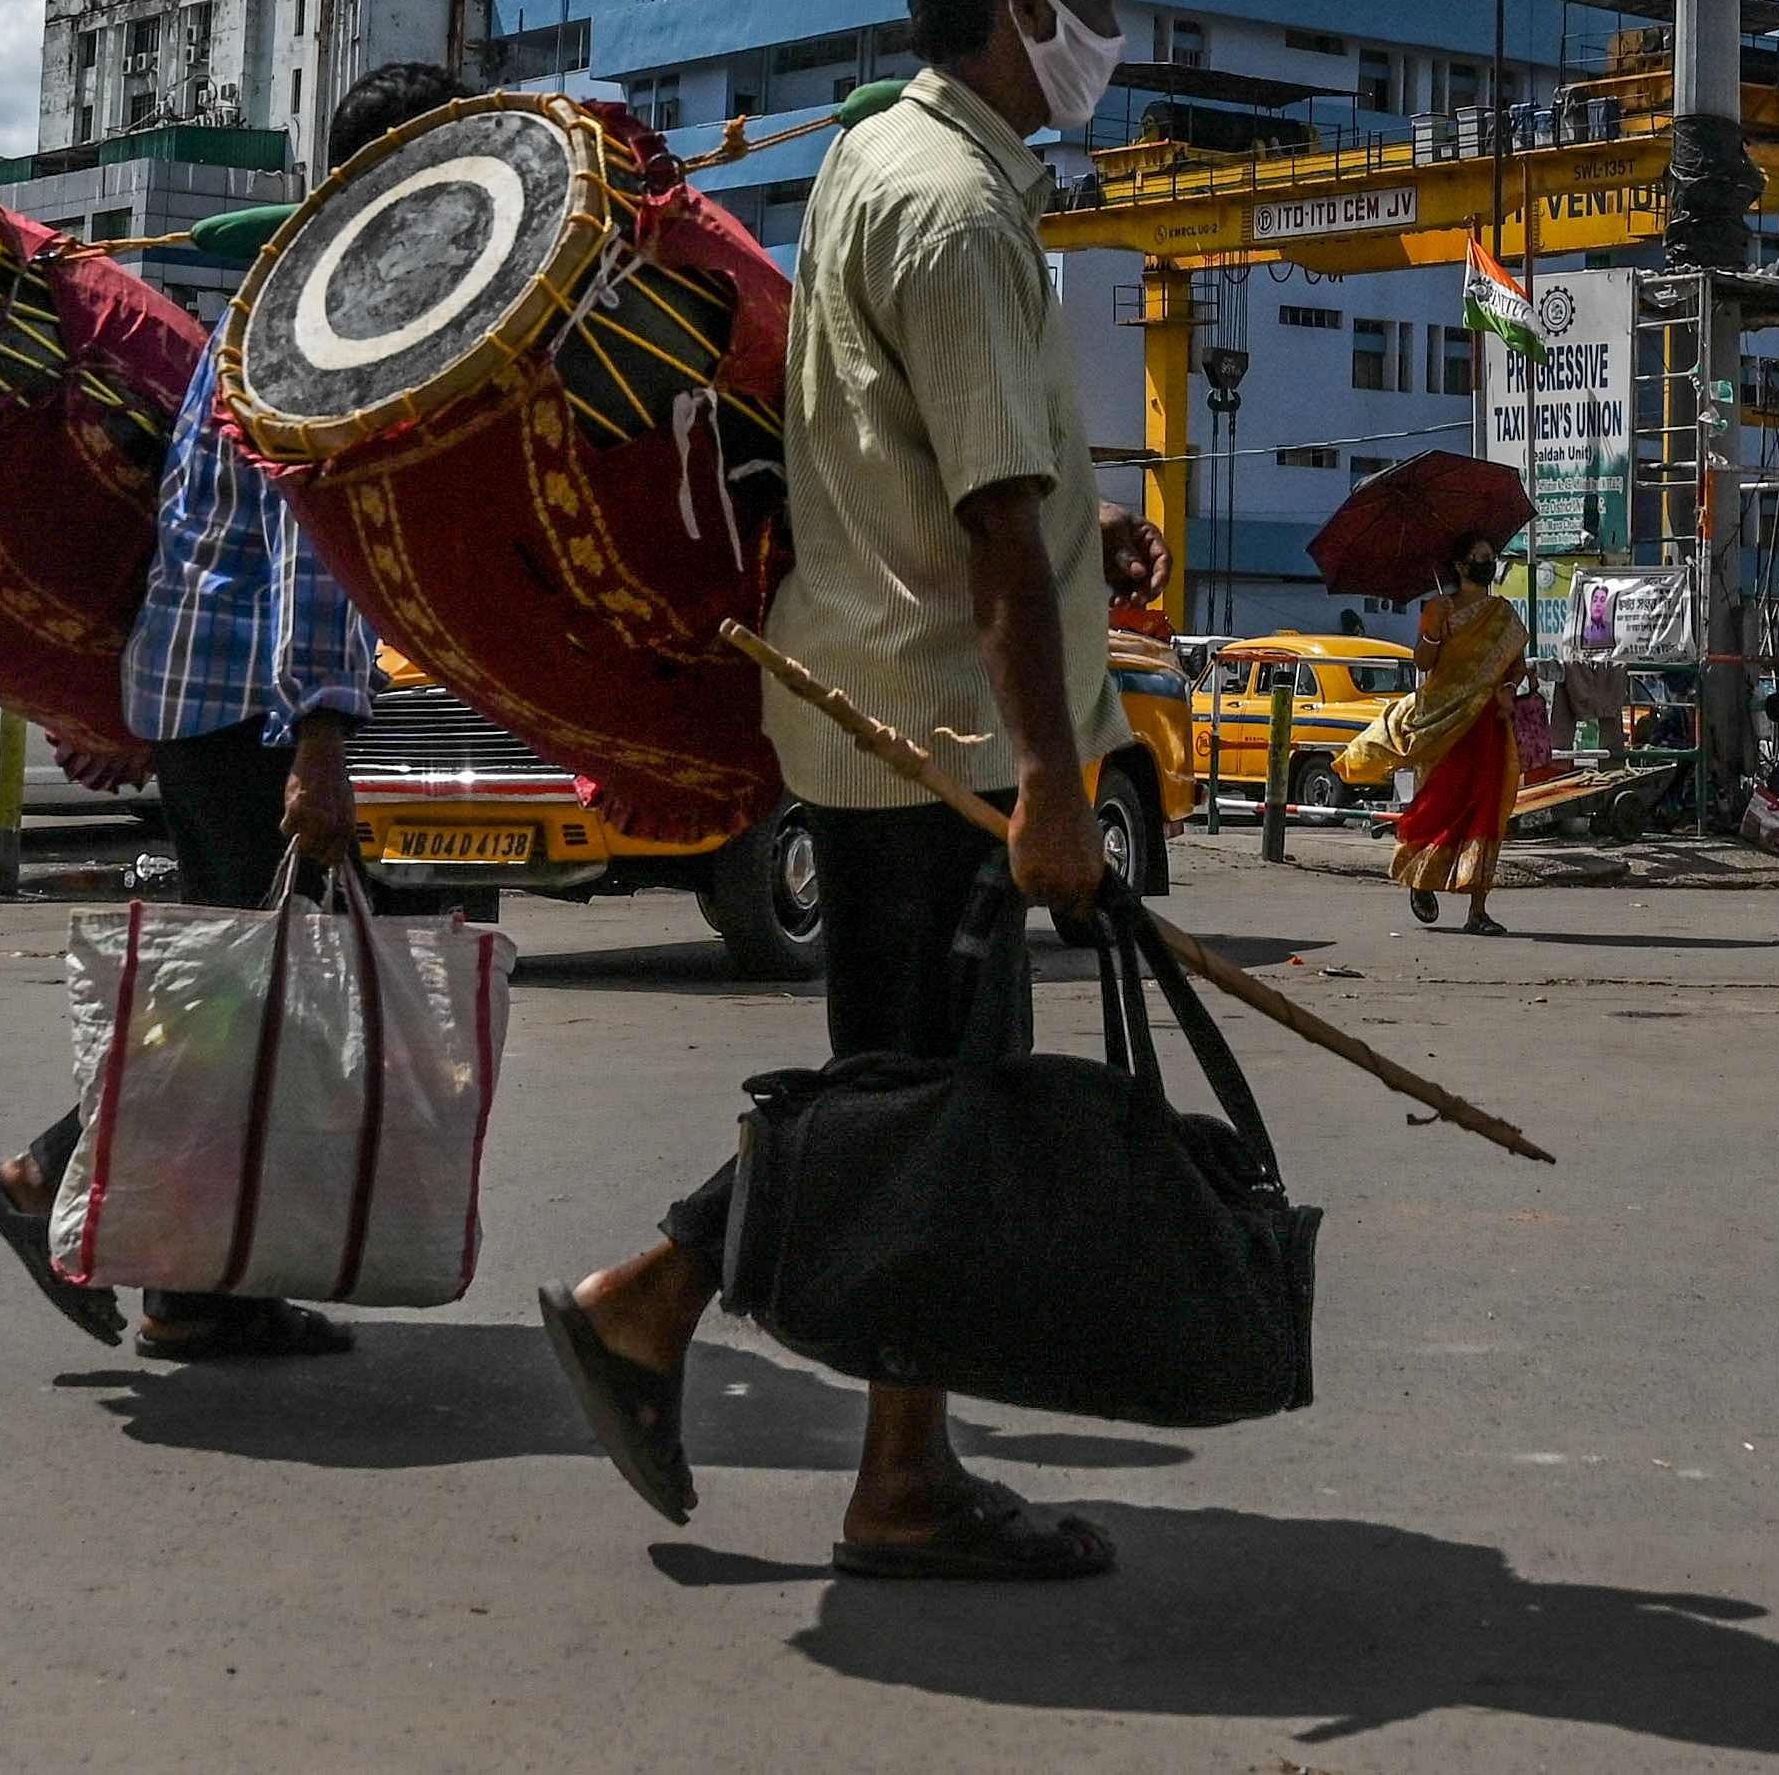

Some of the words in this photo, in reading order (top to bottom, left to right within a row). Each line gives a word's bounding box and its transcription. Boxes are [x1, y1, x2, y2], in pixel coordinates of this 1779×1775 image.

[1573, 159, 1633, 181] SWL-135T
[1387, 192, 1413, 218] JV
[1506, 344, 1609, 393] PRGRESSIVE
[1494, 405, 1525, 442] TAXI
[1576, 400, 1623, 438] UNION
[1523, 448, 1565, 466] (ealdah
[1568, 445, 1593, 464] Unit)
[399, 831, 427, 857] WB
[475, 831, 528, 857] 4138
